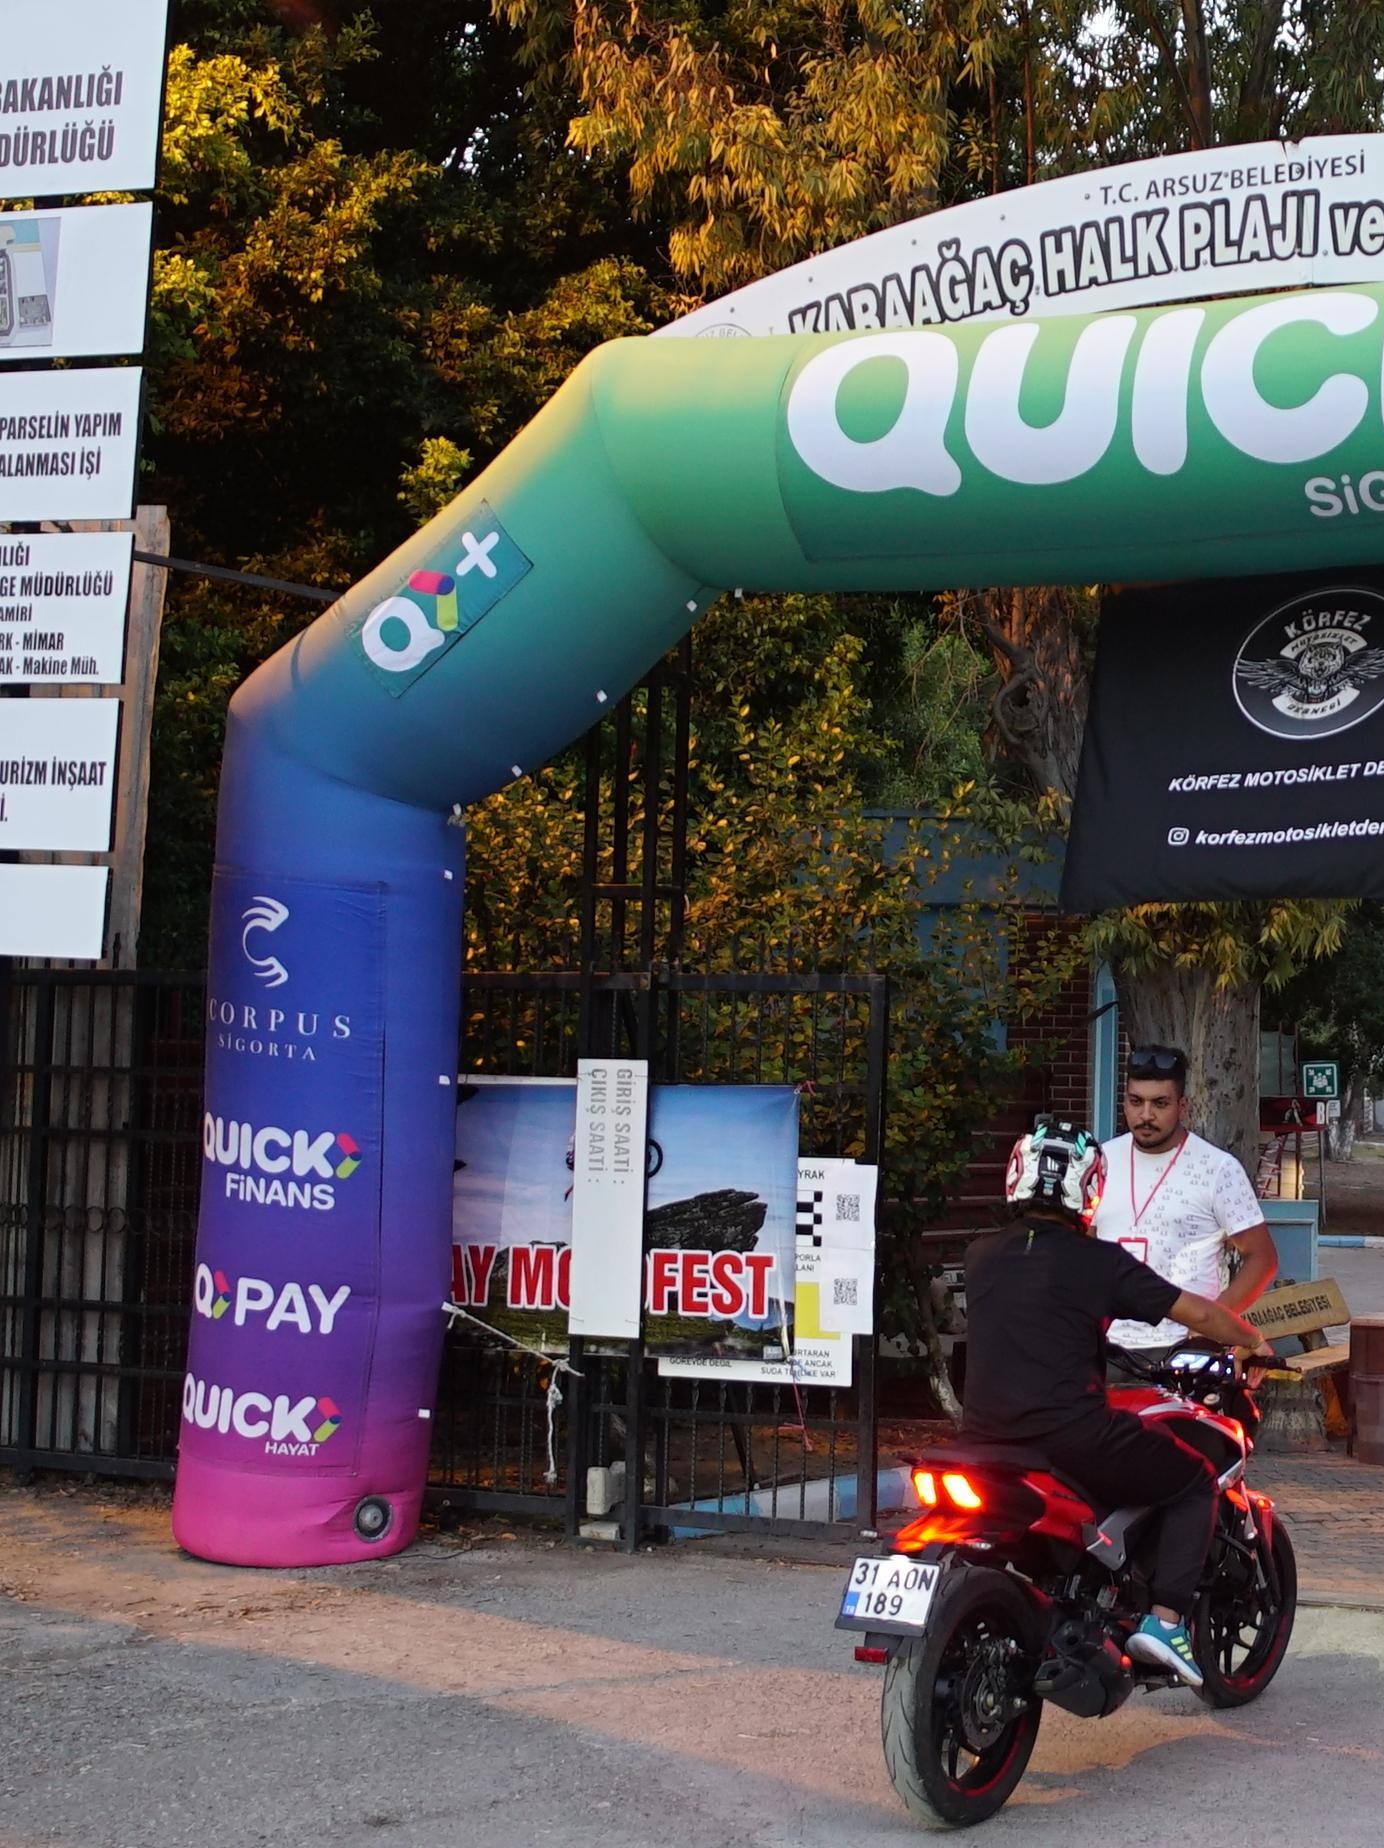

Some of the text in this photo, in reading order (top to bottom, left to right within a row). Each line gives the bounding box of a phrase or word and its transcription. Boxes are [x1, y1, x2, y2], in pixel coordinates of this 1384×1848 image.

[0, 64, 123, 113] AKANLIĞI
[1100, 149, 1365, 205] T.C. ARSUZ BELEDİYESİ
[1040, 206, 1172, 297] HALK
[1178, 189, 1321, 269] PLAJI
[75, 412, 122, 437] YAPIM
[79, 446, 102, 480] İŞİ
[0, 541, 30, 566] LIĞI
[20, 570, 114, 597] MÜDÜRLÜĞÜ
[22, 629, 65, 651] MİMAR
[1284, 609, 1372, 639] KÖRFEZ
[22, 656, 68, 675] Makine
[70, 656, 99, 675] Müh.
[51, 755, 107, 791] İNŞAAT
[1168, 773, 1241, 791] KÖRFEZ
[1244, 763, 1361, 787] MOTOSİKLET
[208, 997, 351, 1039] CORPUS
[217, 1031, 316, 1061] SİGORTA
[585, 1068, 608, 1115] ÇIKIŞ
[611, 1068, 637, 1116] GİRİŞ
[204, 1111, 336, 1179] QUICK
[588, 1121, 609, 1171] SAATİ
[613, 1122, 634, 1173] SAATİ
[797, 1170, 825, 1179] YRAK
[182, 1371, 317, 1443] QUICK
[265, 1441, 320, 1457] HAYAT
[855, 1562, 935, 1591] 31 AON
[865, 1592, 903, 1616] 189
